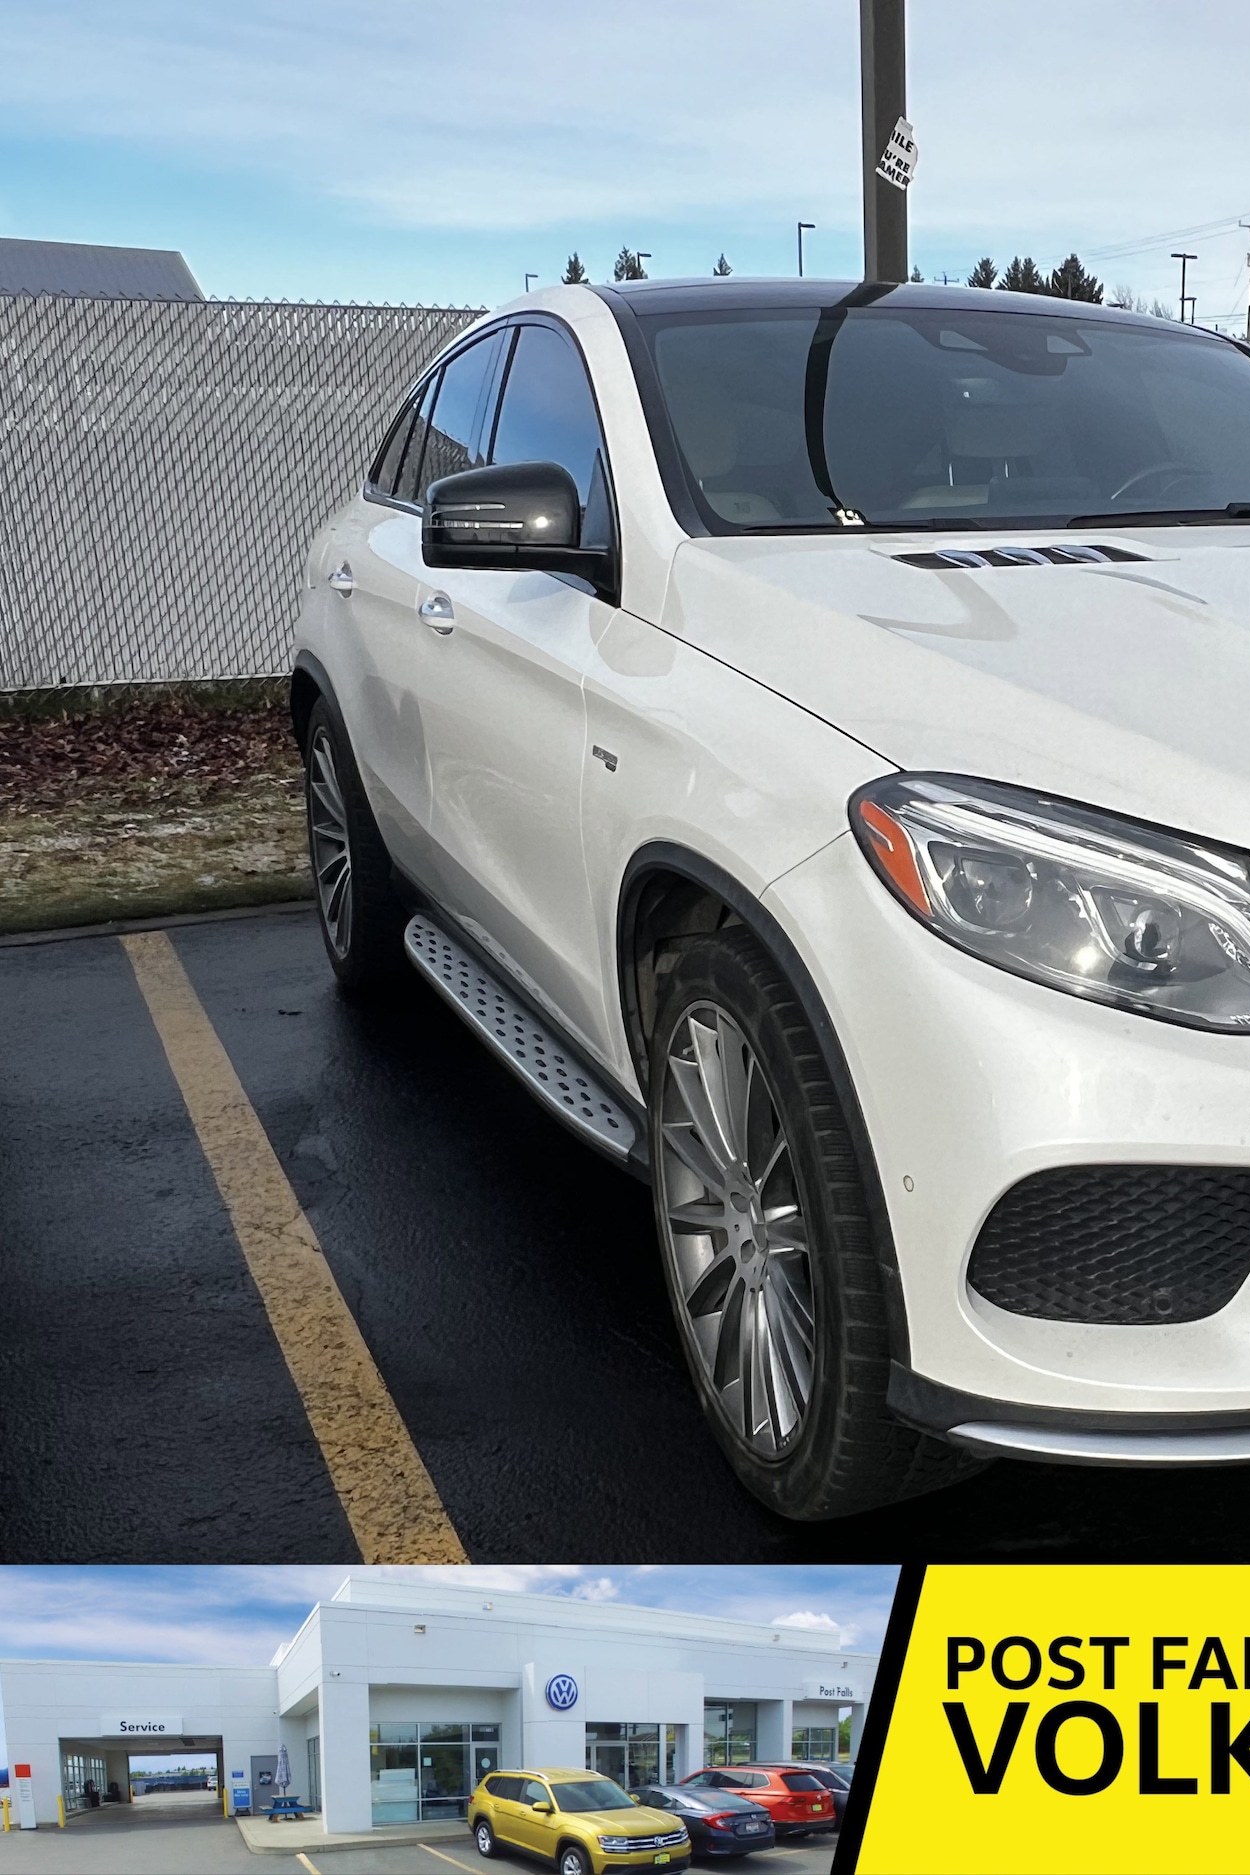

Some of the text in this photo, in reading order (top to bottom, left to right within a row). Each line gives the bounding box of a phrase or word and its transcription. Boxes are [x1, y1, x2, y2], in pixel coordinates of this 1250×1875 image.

[819, 1686, 853, 1698] Post Falls
[120, 1721, 165, 1732] Service
